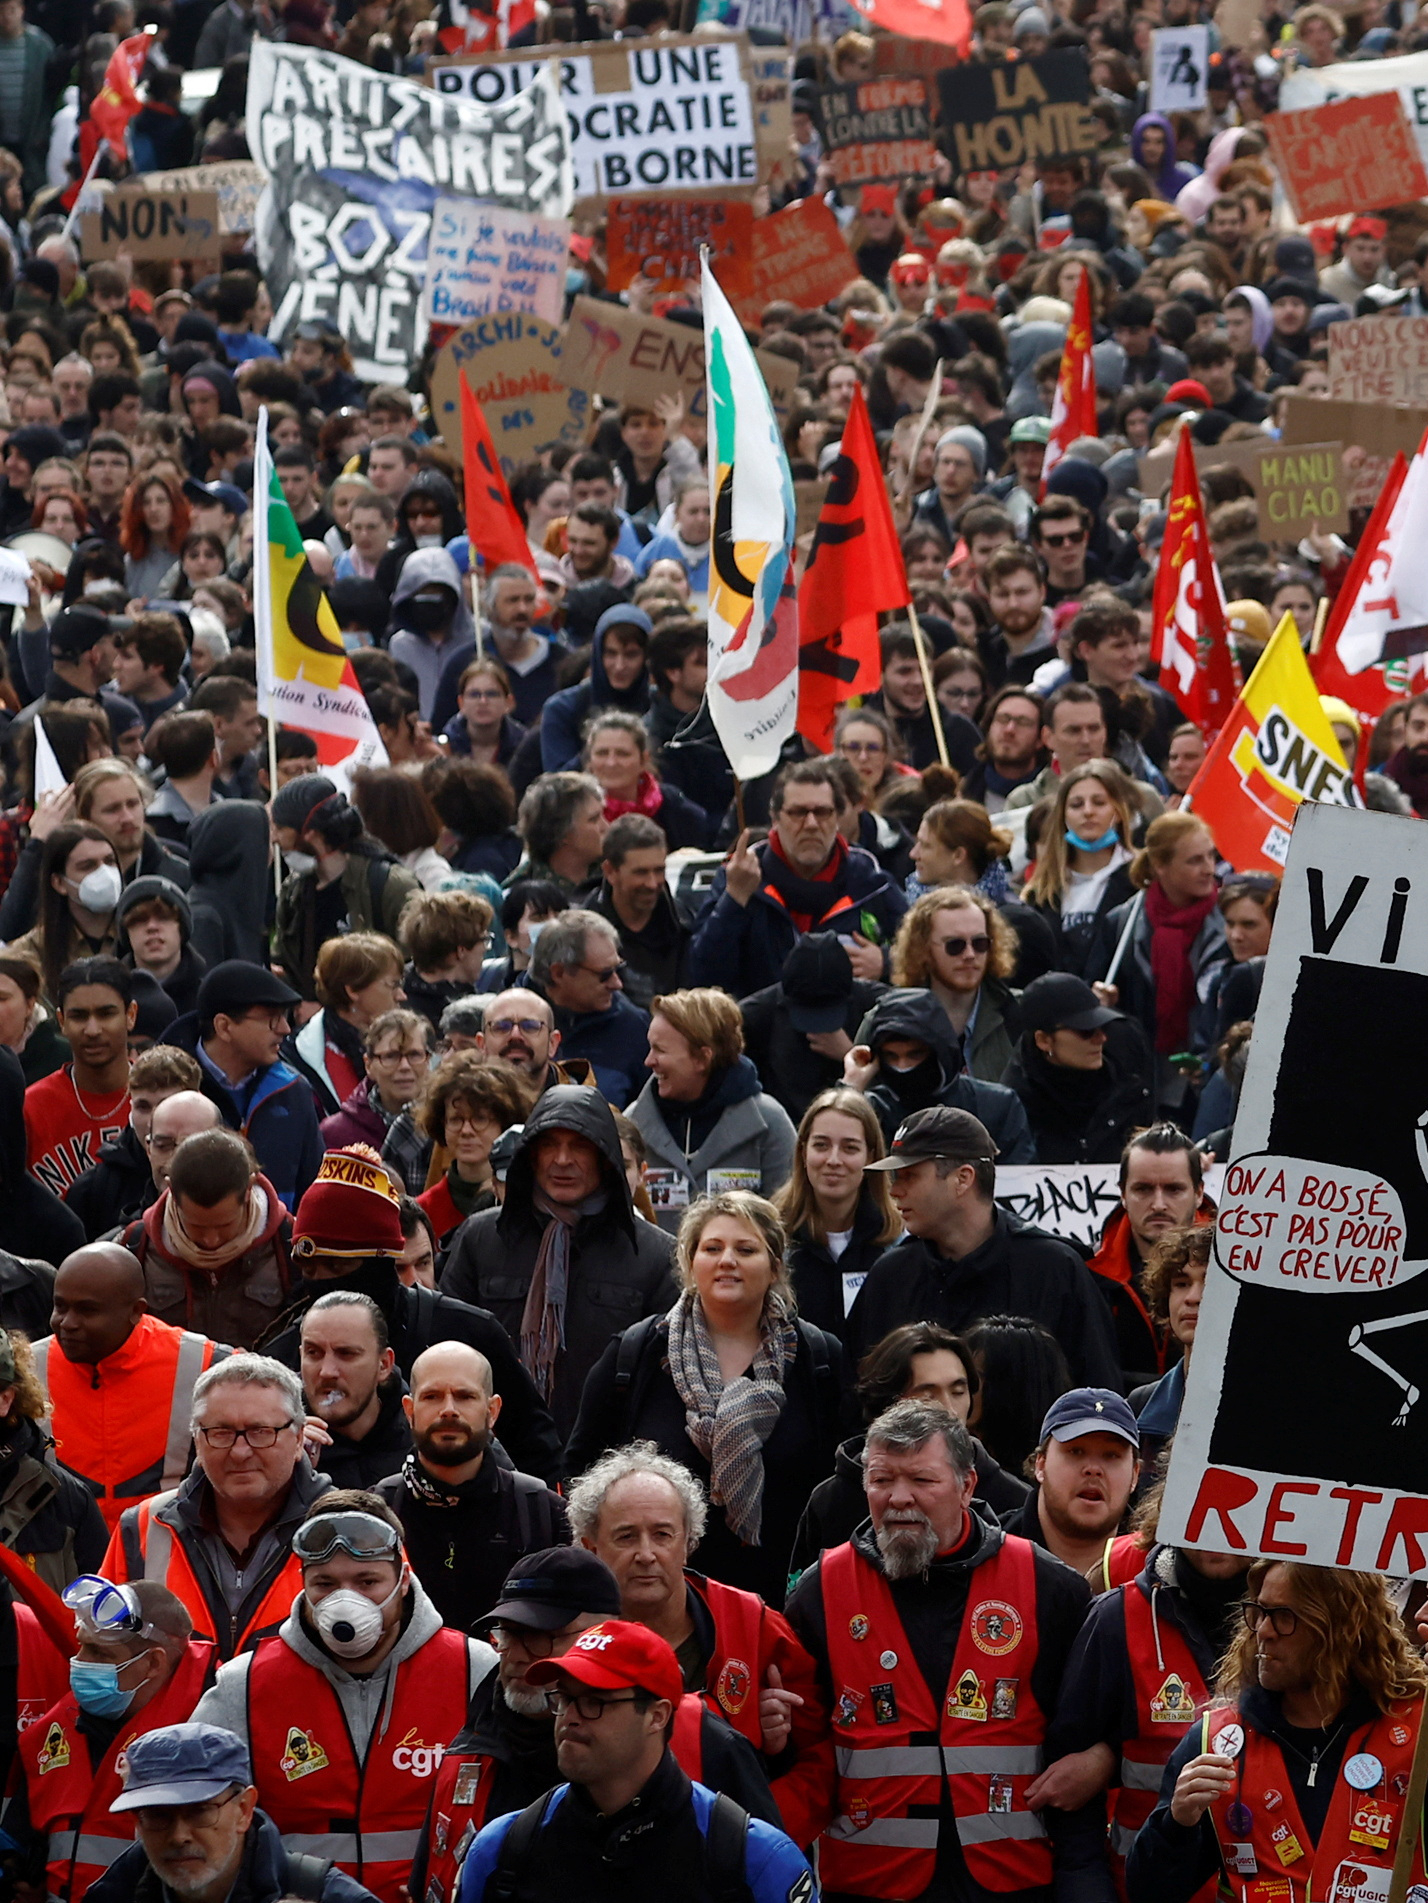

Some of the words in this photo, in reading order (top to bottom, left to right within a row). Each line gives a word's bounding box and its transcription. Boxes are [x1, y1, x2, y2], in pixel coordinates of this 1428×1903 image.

[635, 47, 723, 86] UNE
[991, 63, 1048, 110] LA
[952, 102, 1101, 171] HONTE
[603, 145, 756, 189] BORNE
[451, 316, 523, 365] ARCHI
[1329, 319, 1392, 351] NOUS
[1260, 452, 1335, 488] MANU
[1267, 486, 1340, 523] CIAO
[994, 1174, 1122, 1223] BLACK
[1226, 1165, 1267, 1197] ON
[1265, 1168, 1287, 1204] A
[1297, 1174, 1393, 1225] BOSSÉ,
[1218, 1203, 1279, 1238] C'EST
[1287, 1213, 1330, 1246] PAS
[1335, 1219, 1403, 1252] POUR
[1227, 1244, 1263, 1272] EN
[1278, 1247, 1399, 1289] CREVER!
[575, 1634, 615, 1651] cgt
[392, 1744, 446, 1778] cgt
[1271, 1824, 1289, 1842] cgt
[1353, 1811, 1393, 1835] cgt
[1336, 1884, 1357, 1898] cgt
